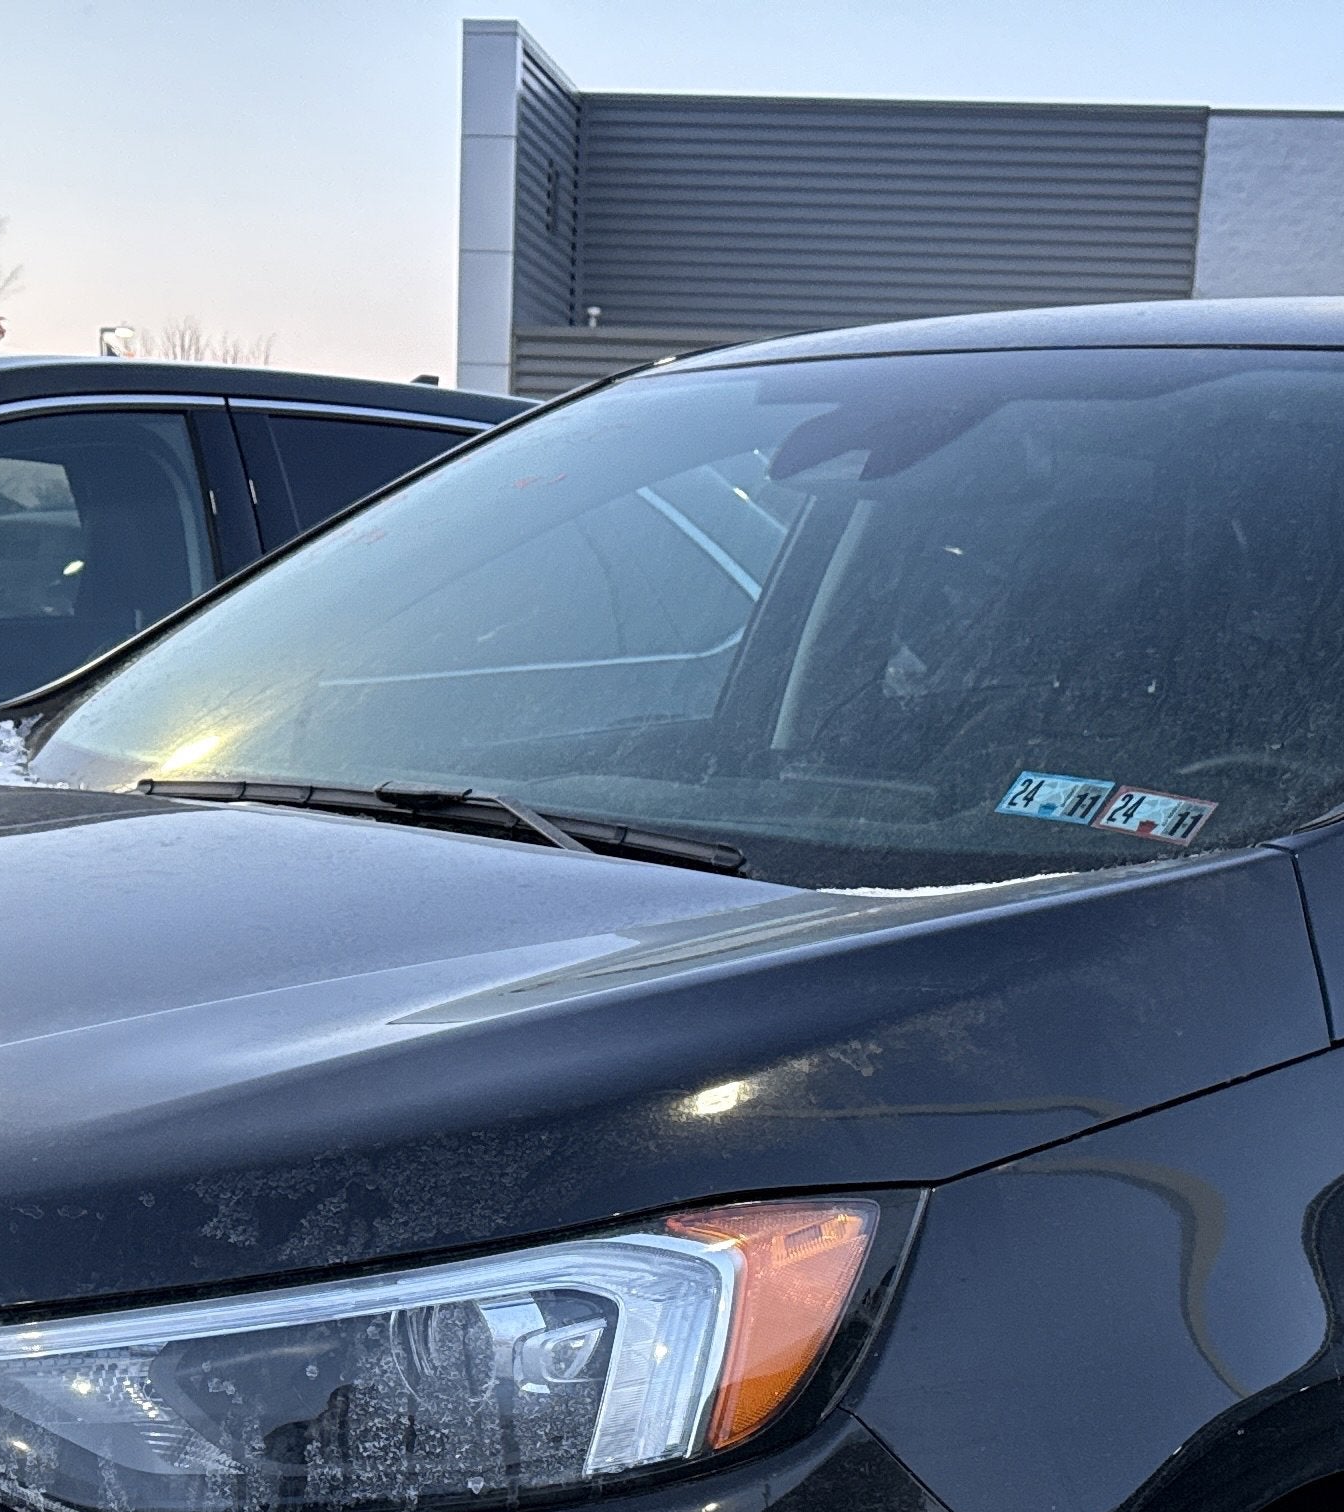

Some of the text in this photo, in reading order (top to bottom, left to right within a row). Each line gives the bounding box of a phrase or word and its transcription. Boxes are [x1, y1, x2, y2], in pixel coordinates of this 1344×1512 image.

[1008, 778, 1046, 808] 24
[1067, 792, 1102, 819] 11
[1106, 793, 1146, 824] 24
[1168, 811, 1203, 839] 11
